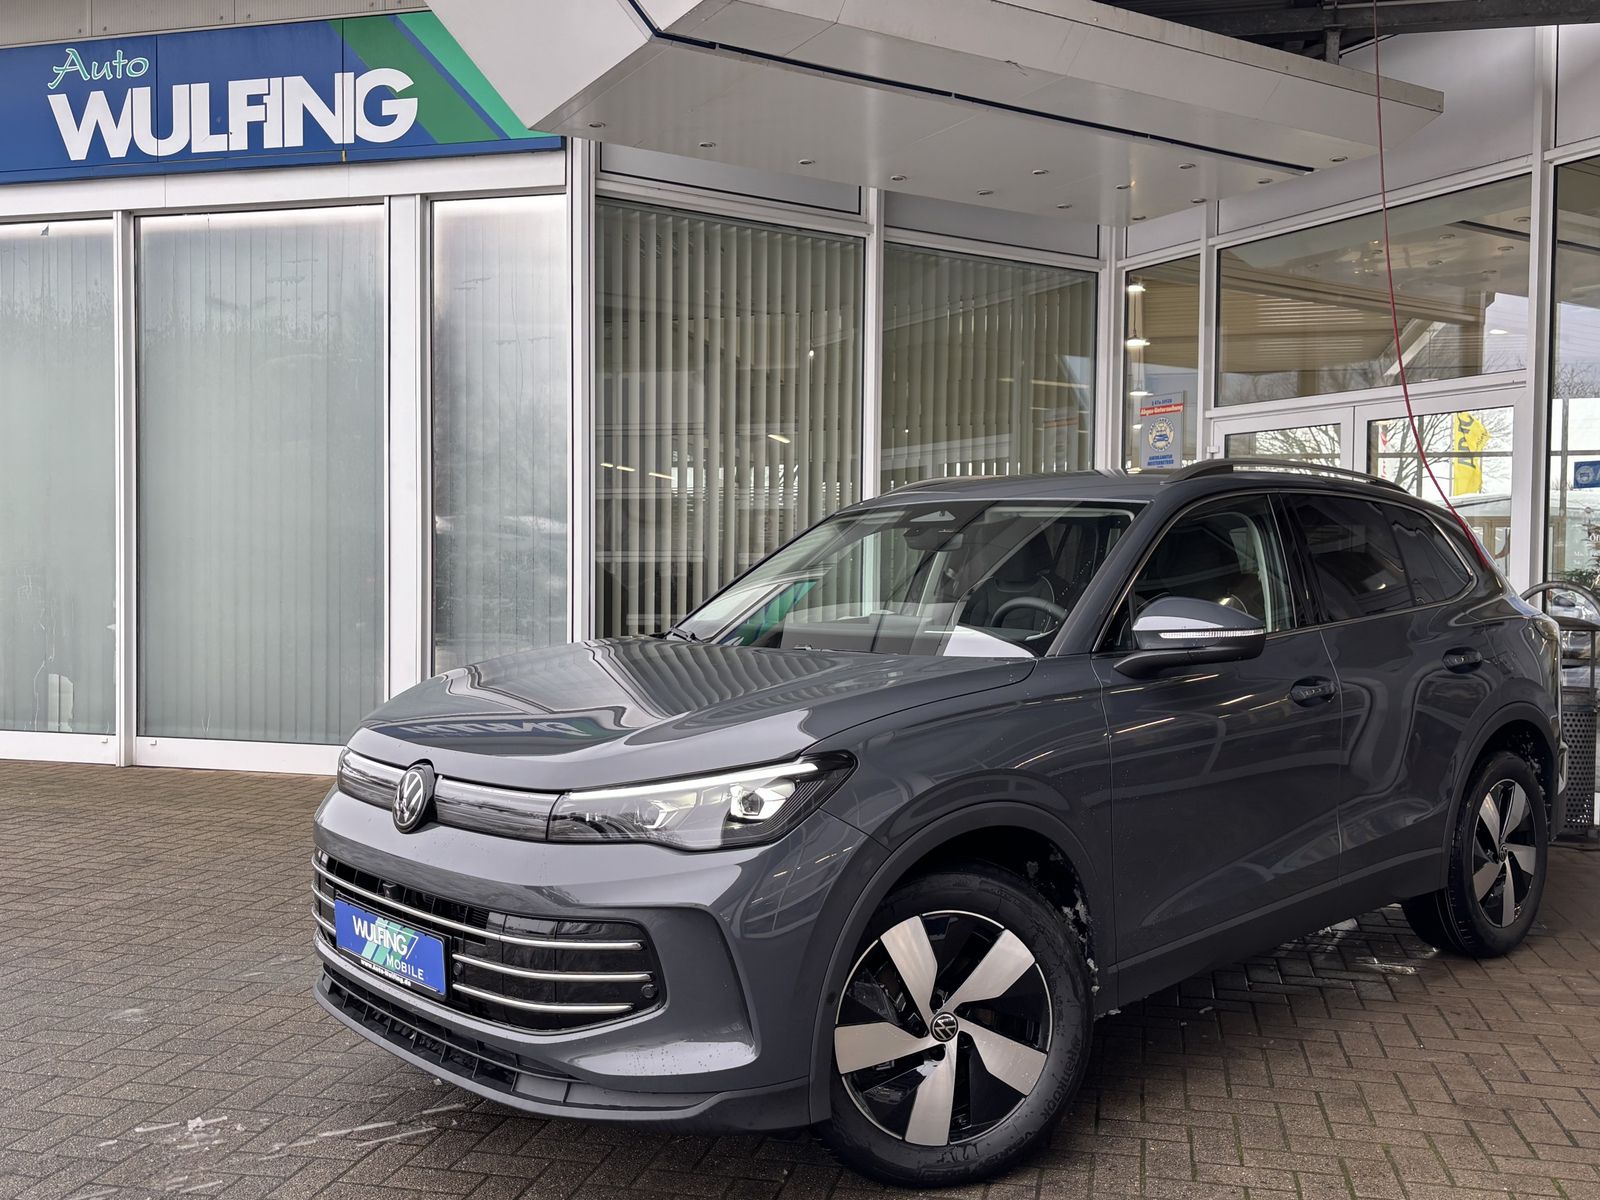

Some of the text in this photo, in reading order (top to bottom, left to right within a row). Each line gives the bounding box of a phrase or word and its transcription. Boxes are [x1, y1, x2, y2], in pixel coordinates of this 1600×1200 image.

[48, 48, 149, 90] Auto
[47, 67, 418, 161] WULFING
[352, 915, 408, 956] WULFING
[386, 954, 425, 980] MOBILE
